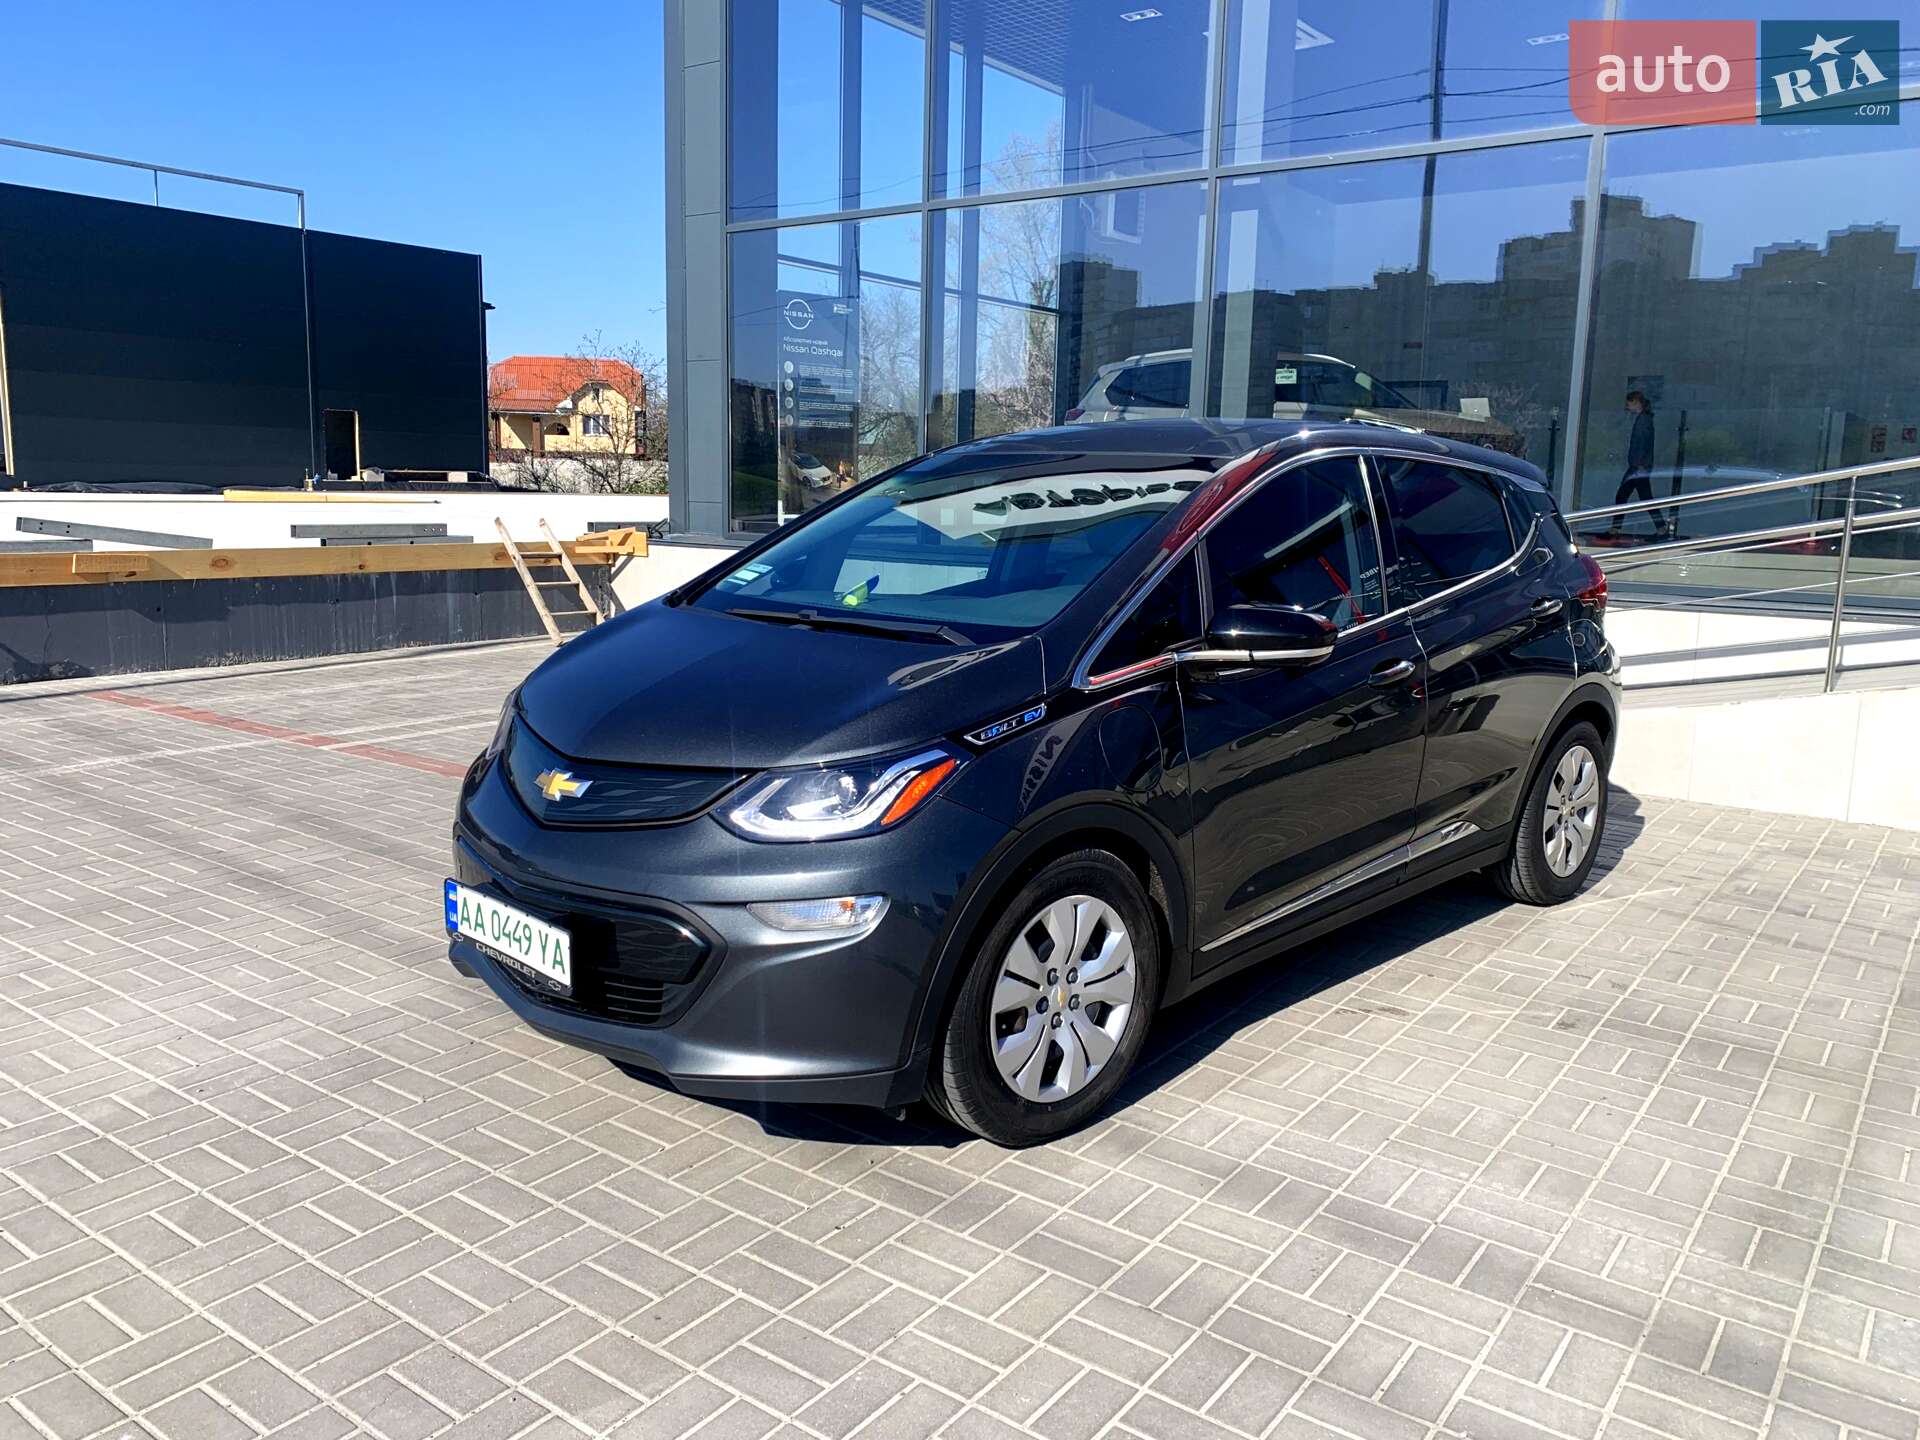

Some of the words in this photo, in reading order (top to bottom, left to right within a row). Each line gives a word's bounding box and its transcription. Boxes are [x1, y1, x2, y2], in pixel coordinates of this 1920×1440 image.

[783, 310, 814, 318] NISSAN
[784, 344, 810, 353] Nissan
[811, 346, 843, 357] Qashqai
[981, 718, 1020, 740] BOLT
[1024, 708, 1041, 722] EV
[449, 911, 458, 924] UA
[460, 896, 486, 936] AA
[491, 909, 533, 956] 0449
[538, 931, 566, 975] YA
[475, 942, 537, 979] CHEVROLET
